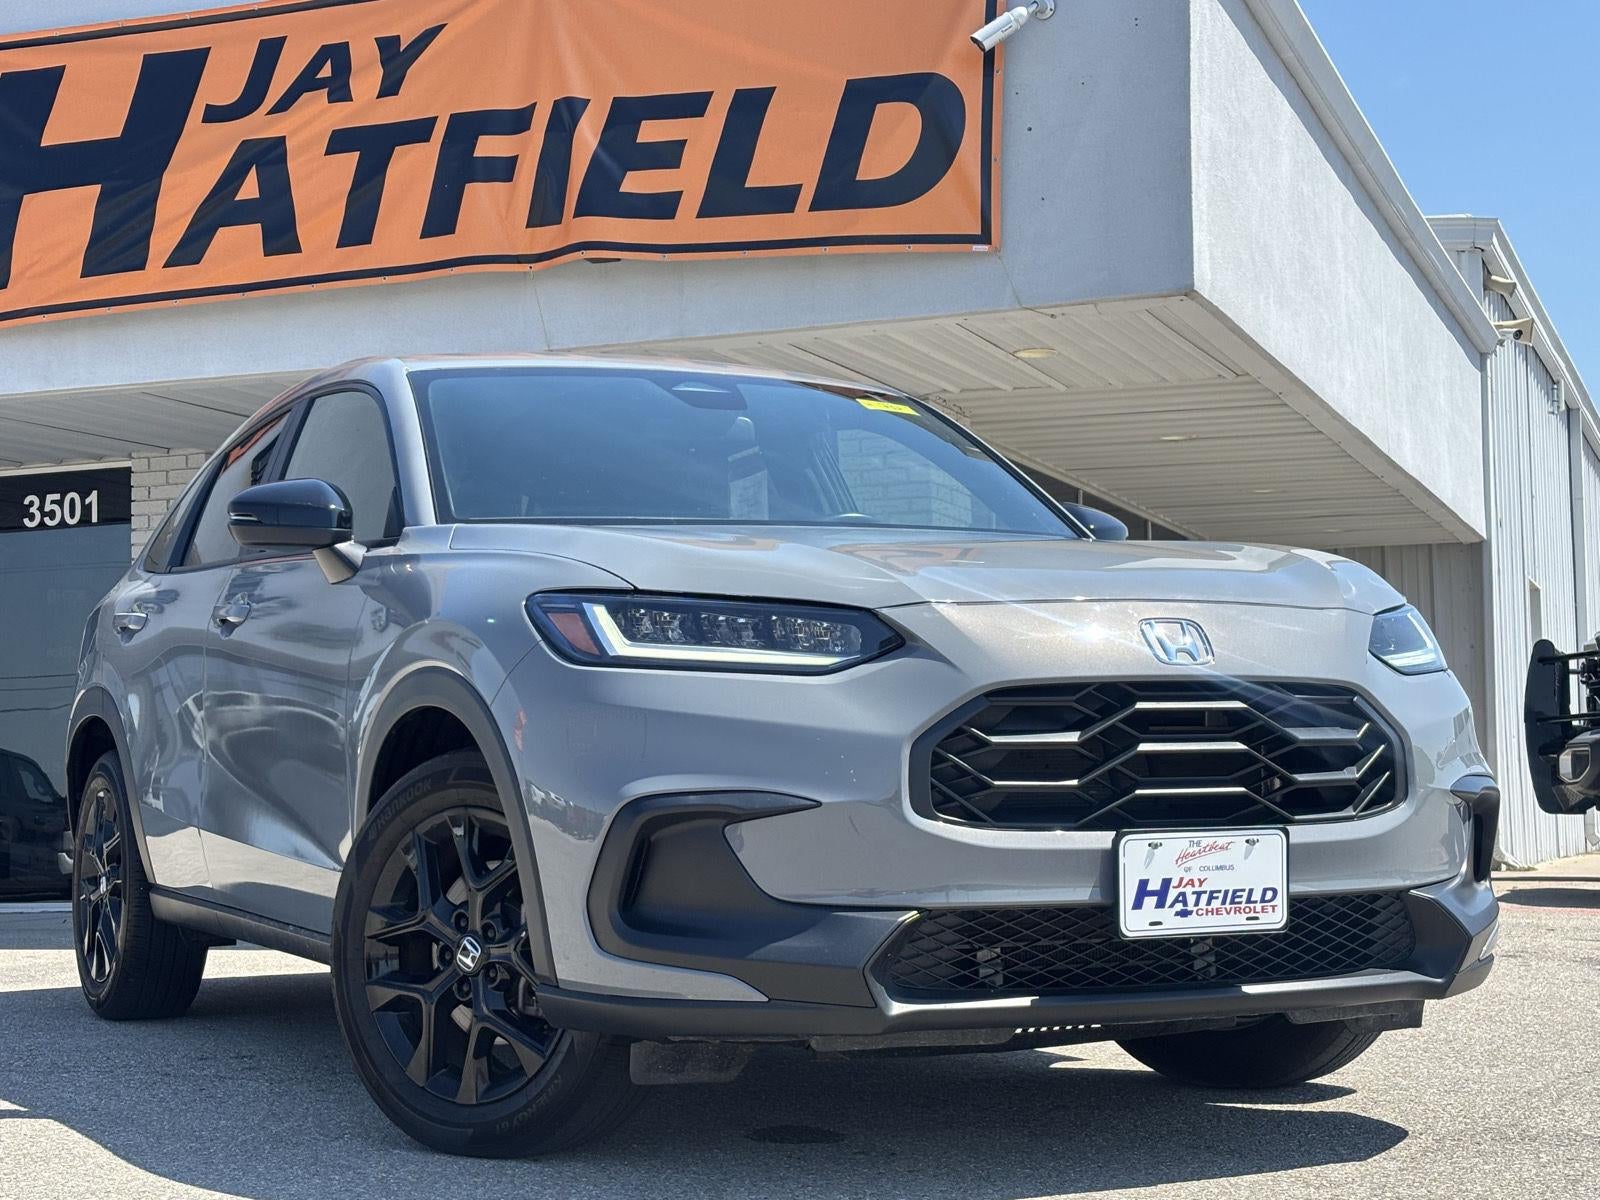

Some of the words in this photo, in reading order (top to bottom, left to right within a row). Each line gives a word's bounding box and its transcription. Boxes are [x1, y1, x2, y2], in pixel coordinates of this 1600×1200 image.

[202, 24, 447, 124] JAY
[0, 47, 967, 290] HATFIELD
[22, 489, 99, 528] 3501
[1175, 840, 1235, 866] Heartbeat
[1188, 839, 1203, 848] THE
[1183, 865, 1192, 873] OF
[1198, 864, 1235, 873] COLUMBUS
[1131, 877, 1279, 911] HATFIELD
[1171, 876, 1209, 890] JAY
[1195, 904, 1279, 917] CHEVROLET
